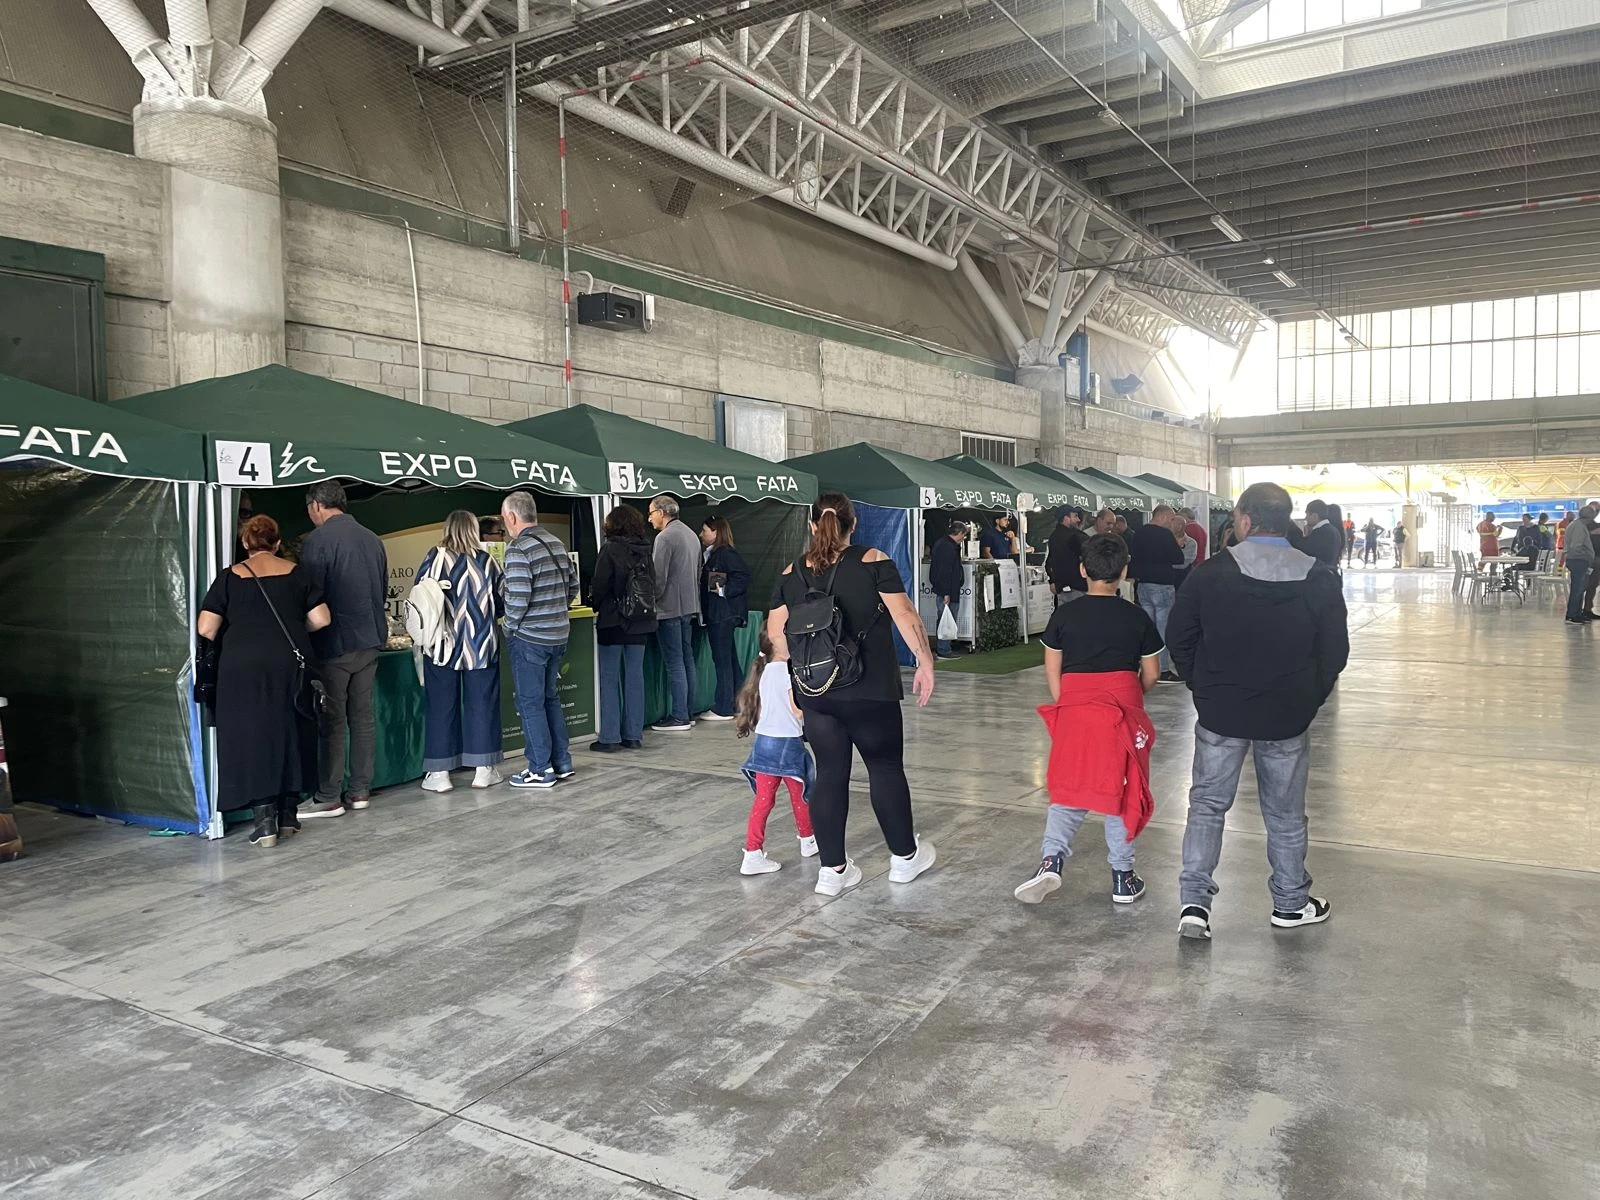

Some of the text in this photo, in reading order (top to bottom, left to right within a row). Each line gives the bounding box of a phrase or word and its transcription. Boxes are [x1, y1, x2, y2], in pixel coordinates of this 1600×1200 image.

[238, 446, 259, 482] 4
[379, 451, 578, 488] EXPO FATA
[617, 465, 629, 491] 5
[679, 474, 799, 492] EXPO FATA
[924, 489, 931, 506] 6
[954, 490, 1012, 505] EXPO FATA
[1047, 493, 1090, 507] EXPO FATA
[389, 567, 414, 578] ARO
